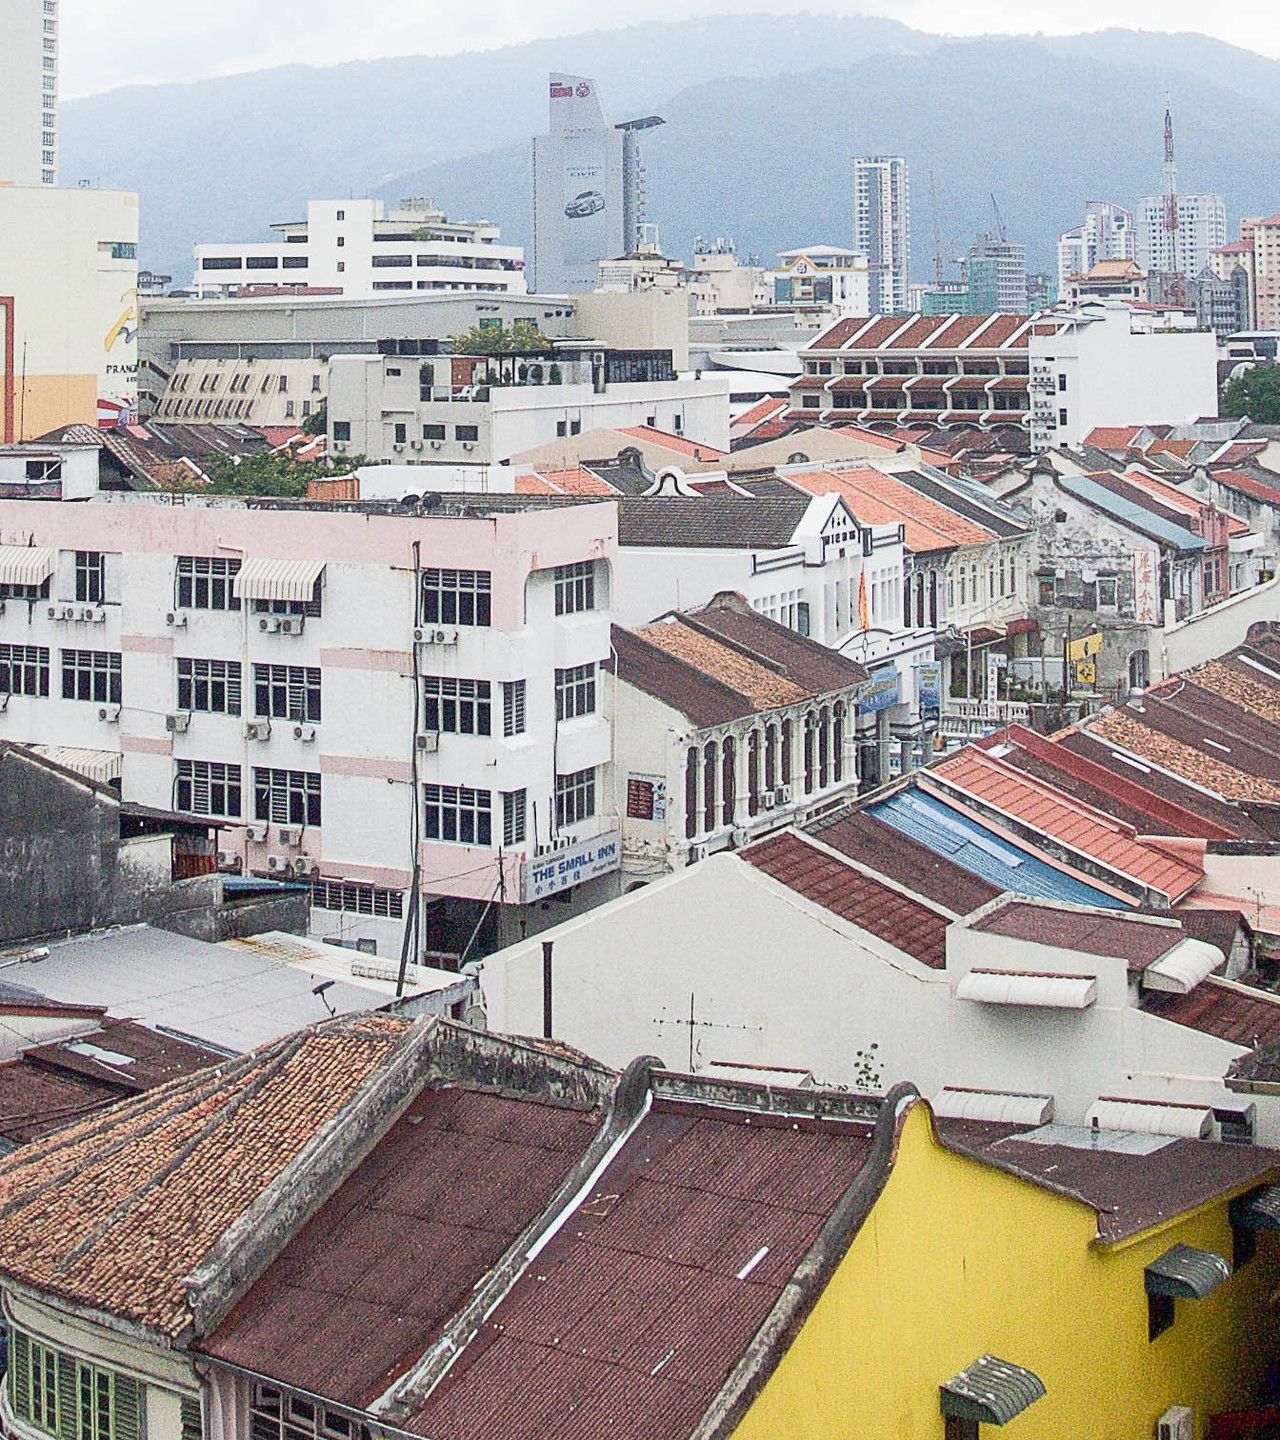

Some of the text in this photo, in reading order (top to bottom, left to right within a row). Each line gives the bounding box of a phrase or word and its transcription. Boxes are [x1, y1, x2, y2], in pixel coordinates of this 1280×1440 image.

[532, 865, 555, 883] THE
[558, 851, 594, 875] SMALL
[597, 842, 616, 860] INN
